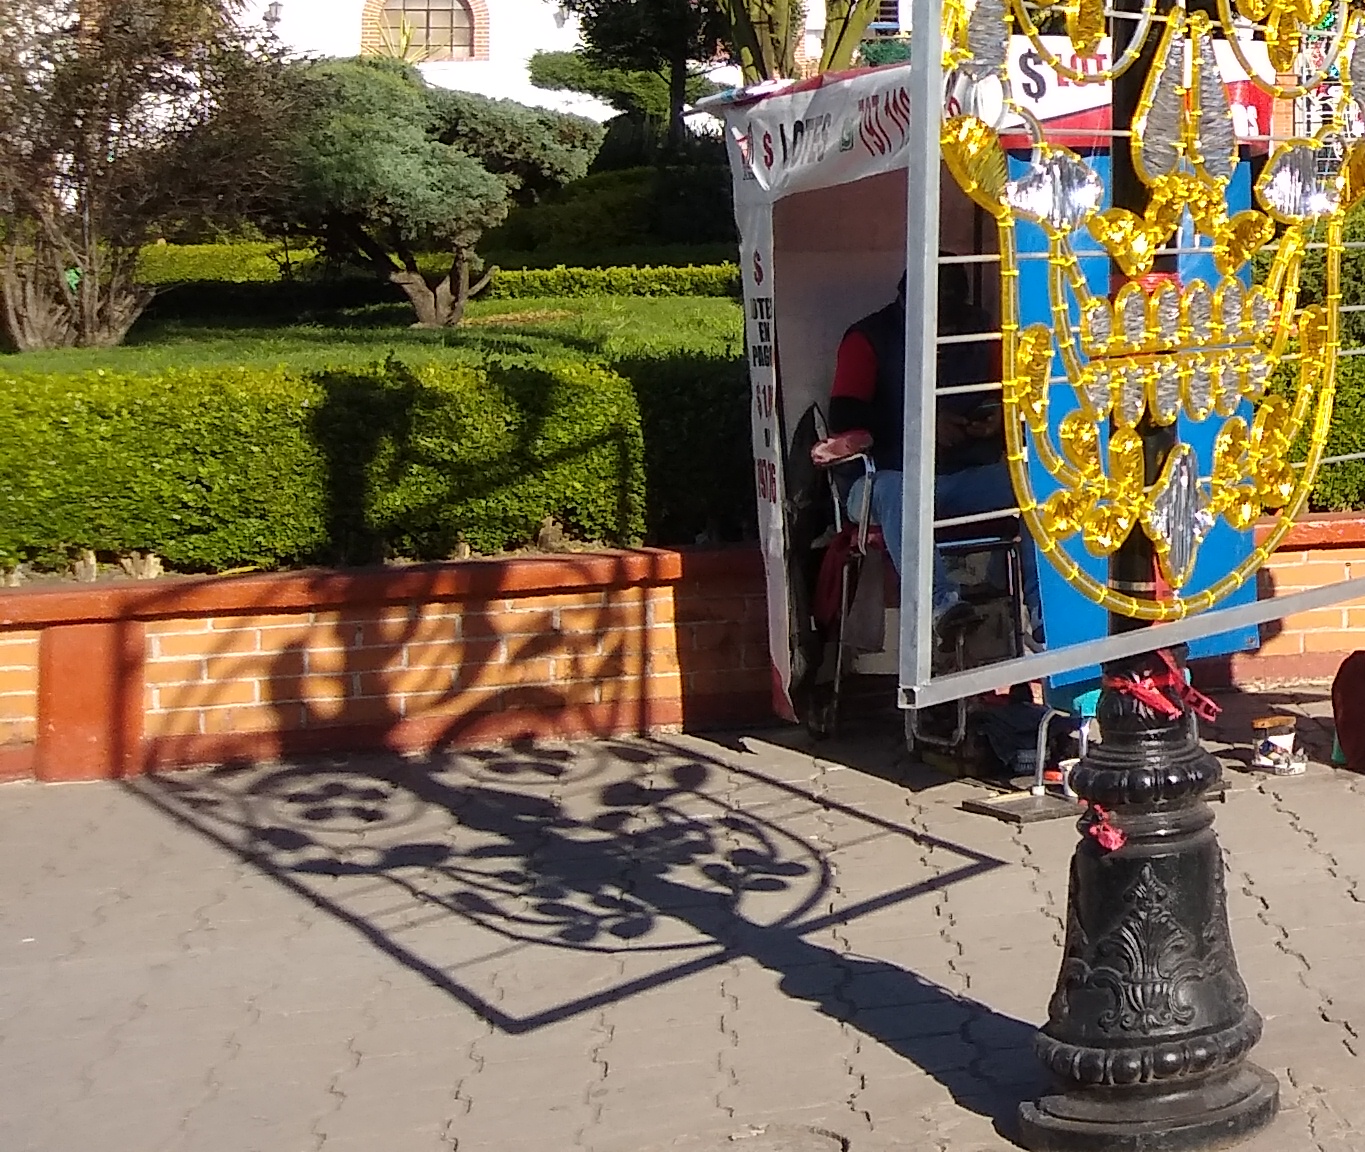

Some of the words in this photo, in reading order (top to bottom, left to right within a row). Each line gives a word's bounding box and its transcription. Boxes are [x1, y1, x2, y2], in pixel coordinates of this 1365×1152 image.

[1019, 50, 1046, 103] $
[1053, 53, 1107, 87] LOT
[763, 130, 774, 170] $
[753, 249, 764, 286] $
